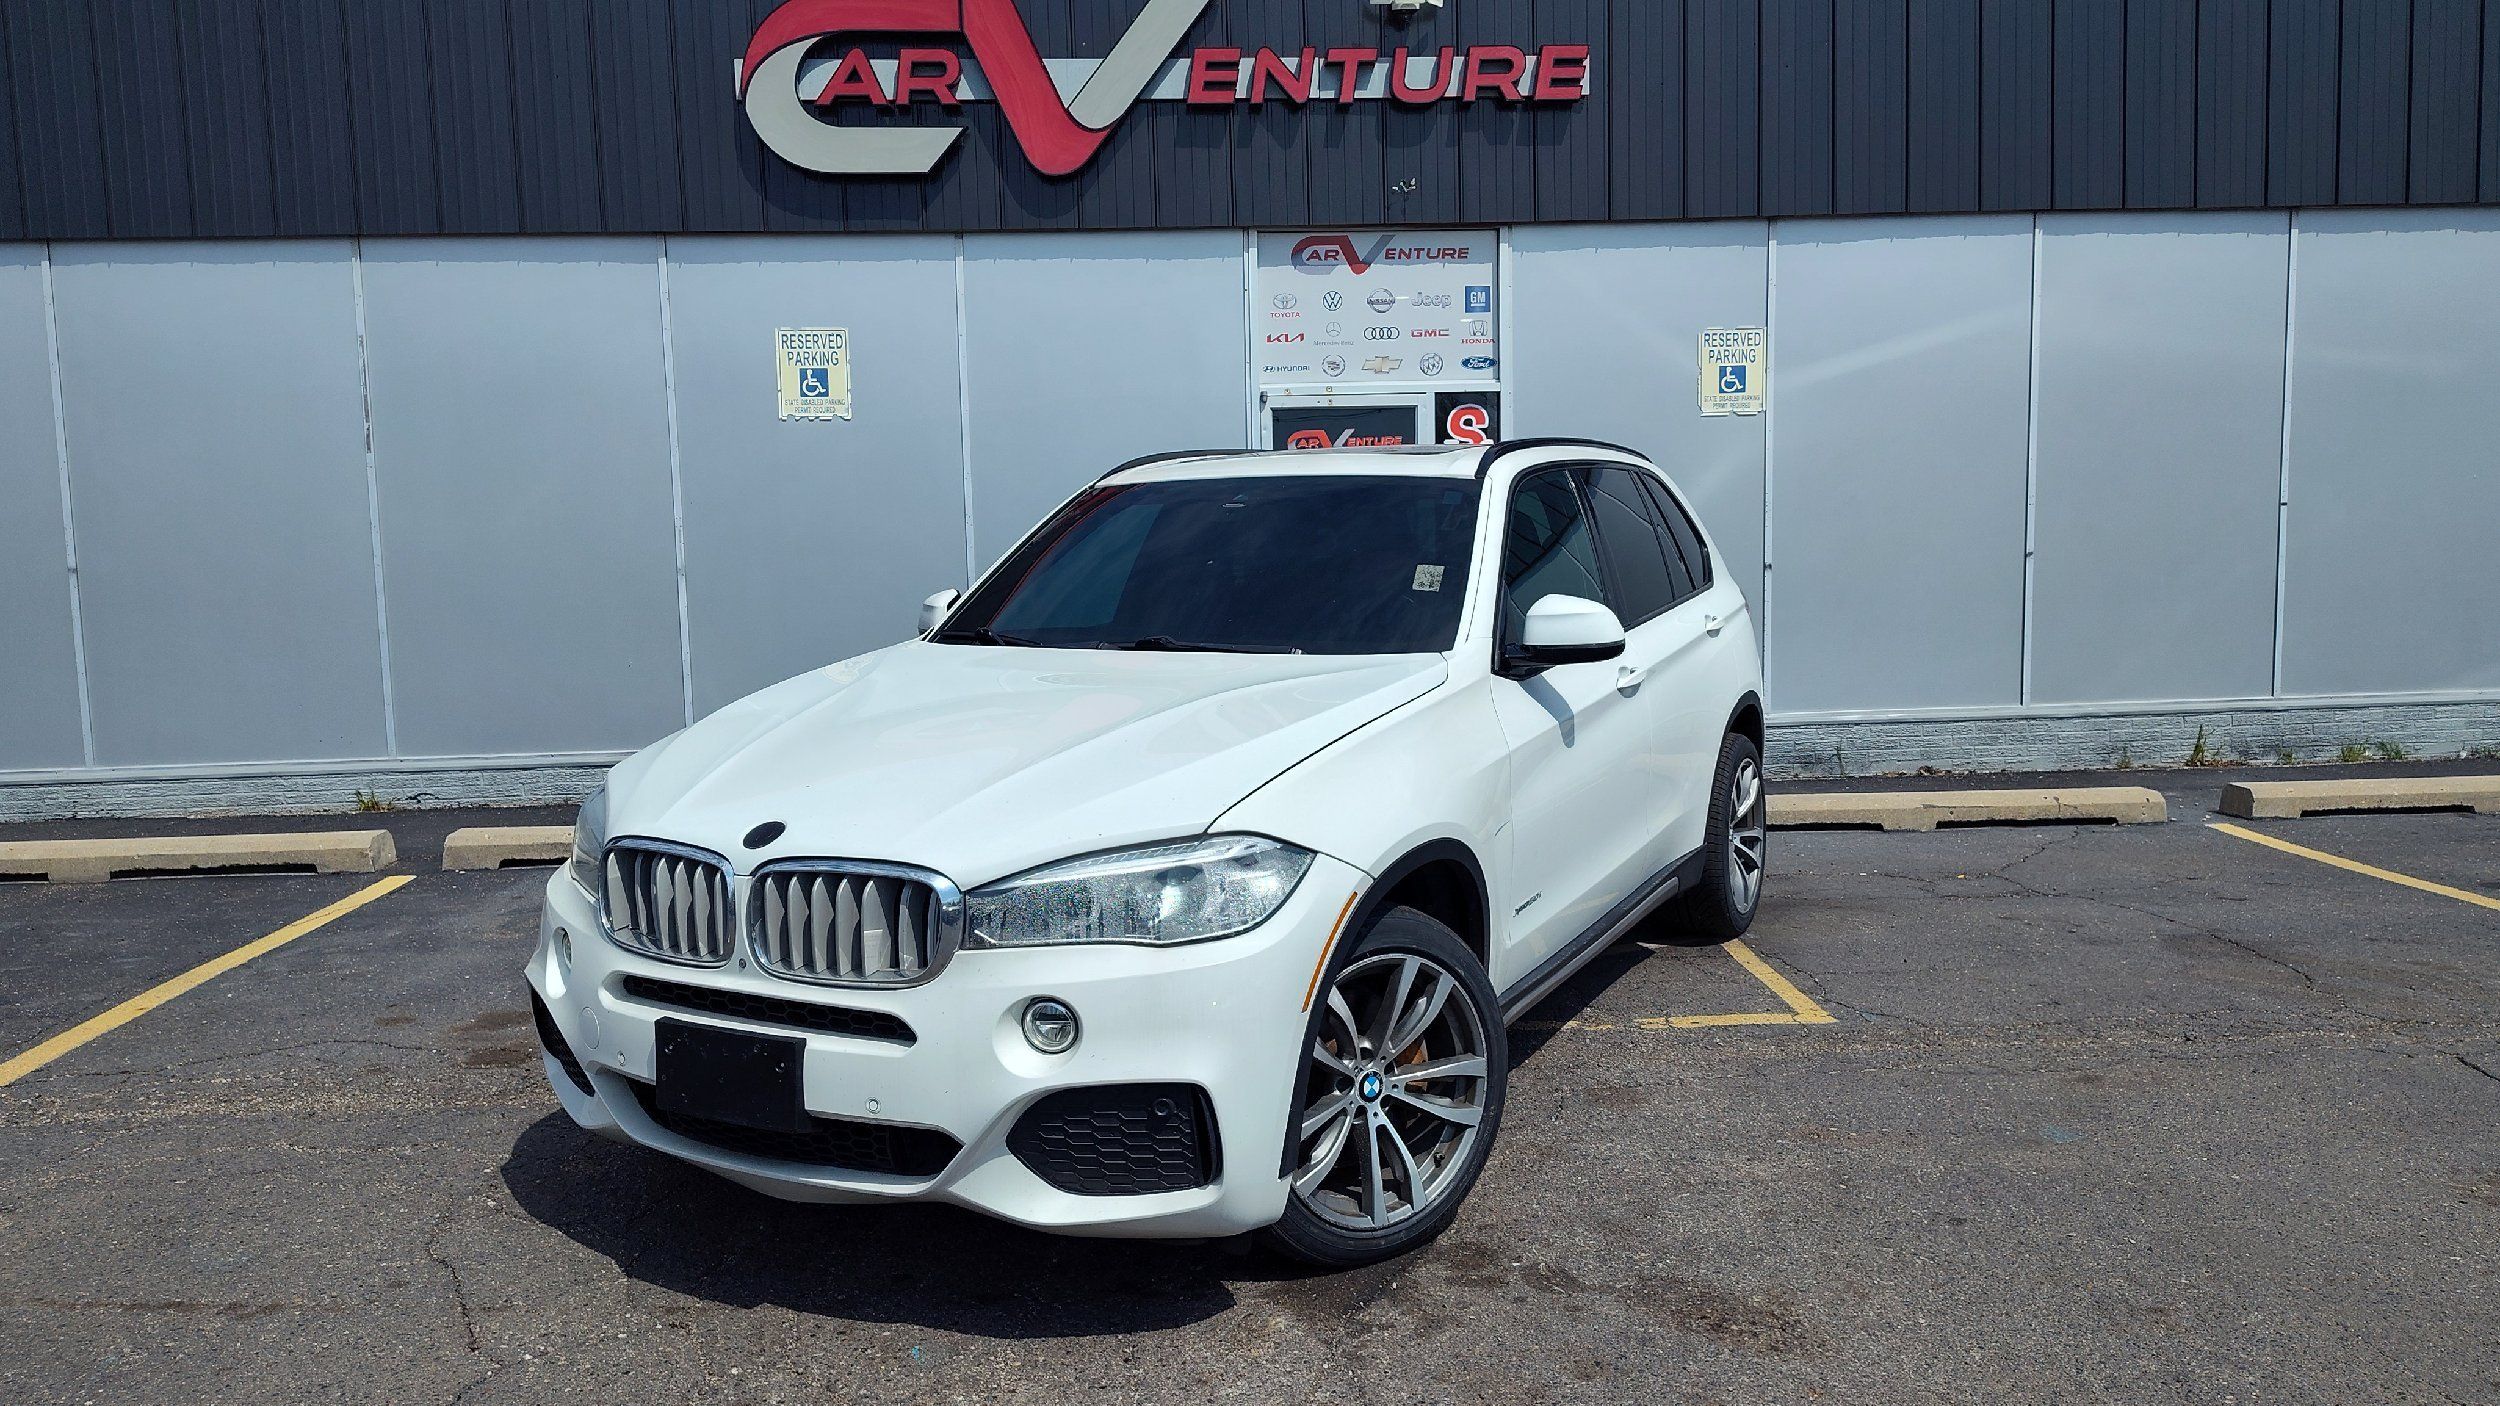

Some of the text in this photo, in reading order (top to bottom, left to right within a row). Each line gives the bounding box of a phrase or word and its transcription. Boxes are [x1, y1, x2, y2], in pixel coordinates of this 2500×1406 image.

[1411, 292, 1452, 309] Jeep
[1470, 291, 1486, 303] GM
[1411, 328, 1450, 338] GMC
[1703, 332, 1762, 348] RESERVED
[781, 333, 844, 350] RESERVED
[787, 351, 840, 366] PARKING
[1708, 348, 1756, 363] PARKING
